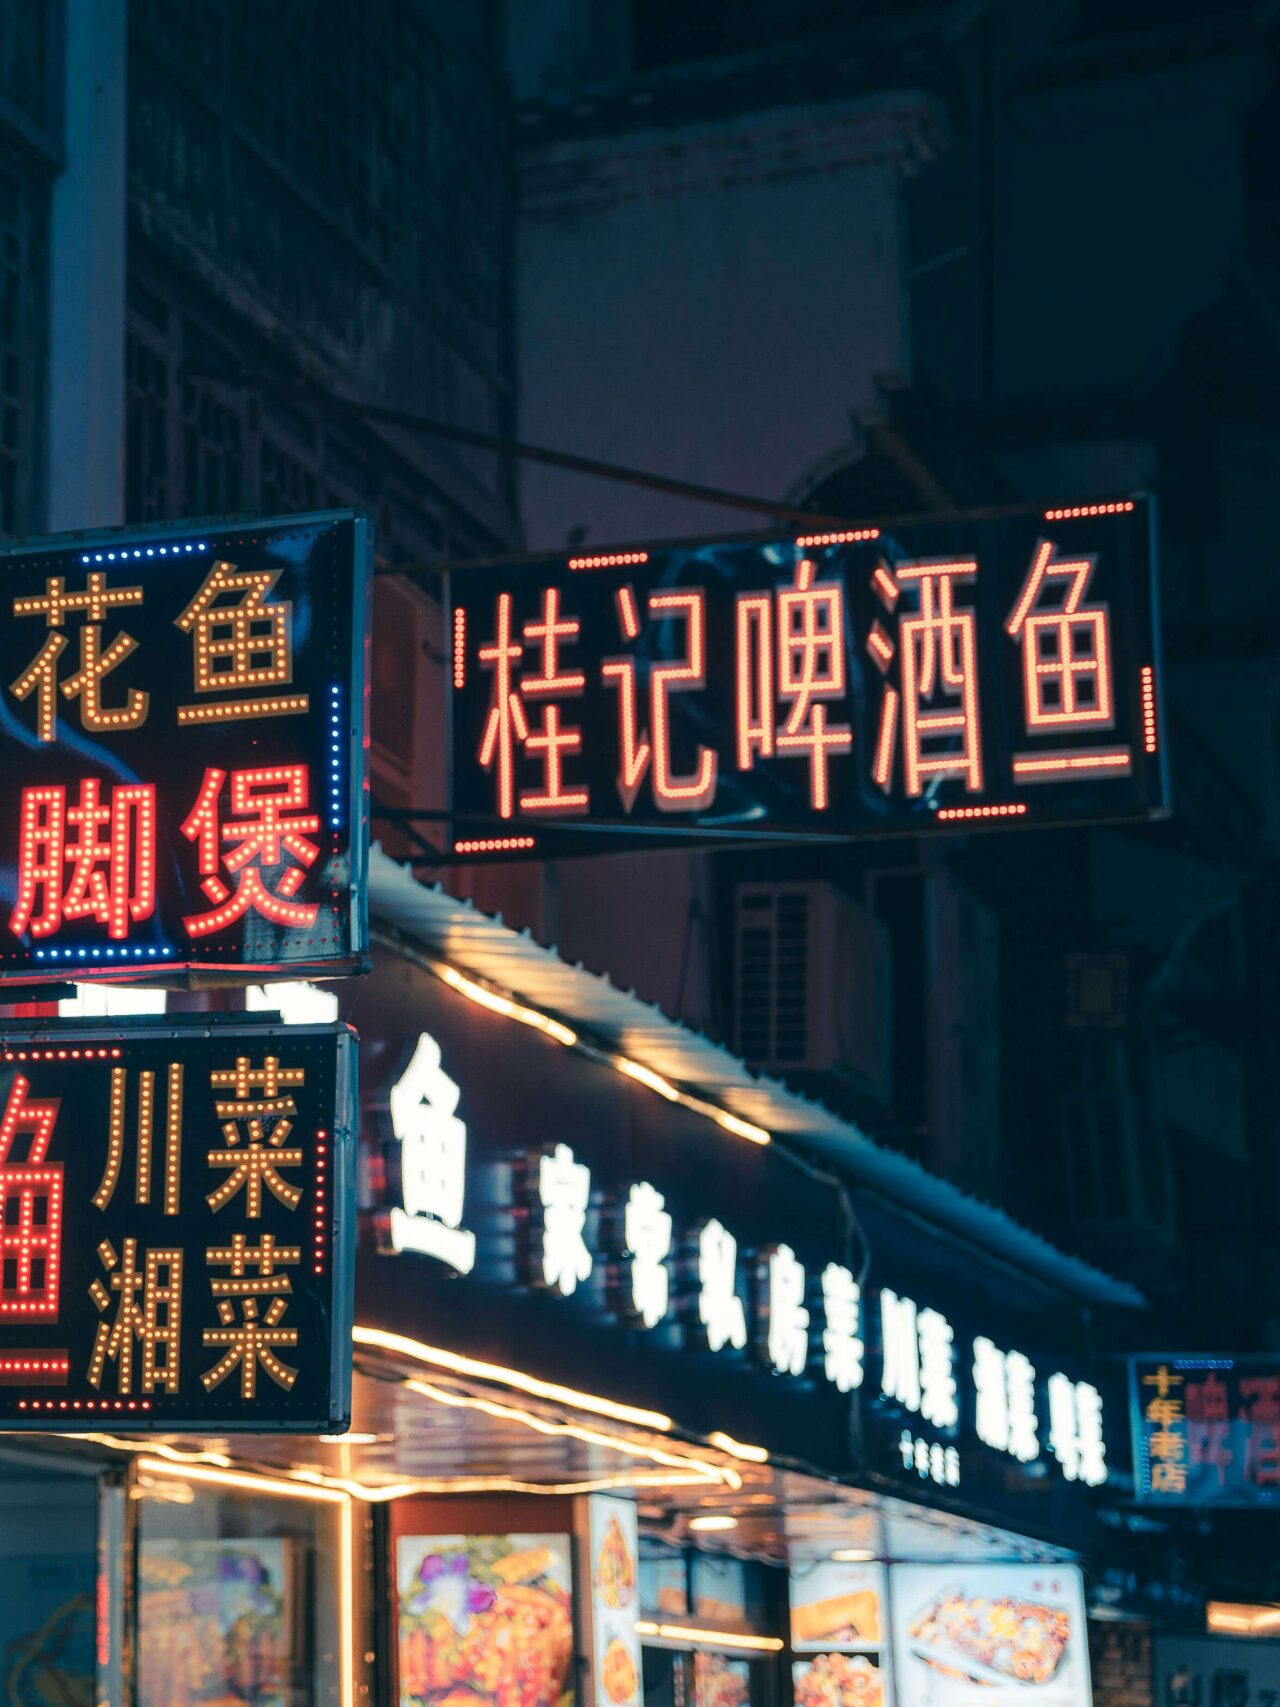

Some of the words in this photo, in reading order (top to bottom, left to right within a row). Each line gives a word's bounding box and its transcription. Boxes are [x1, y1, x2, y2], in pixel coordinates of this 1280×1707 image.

[477, 540, 1132, 820] 桂记啤酒鱼
